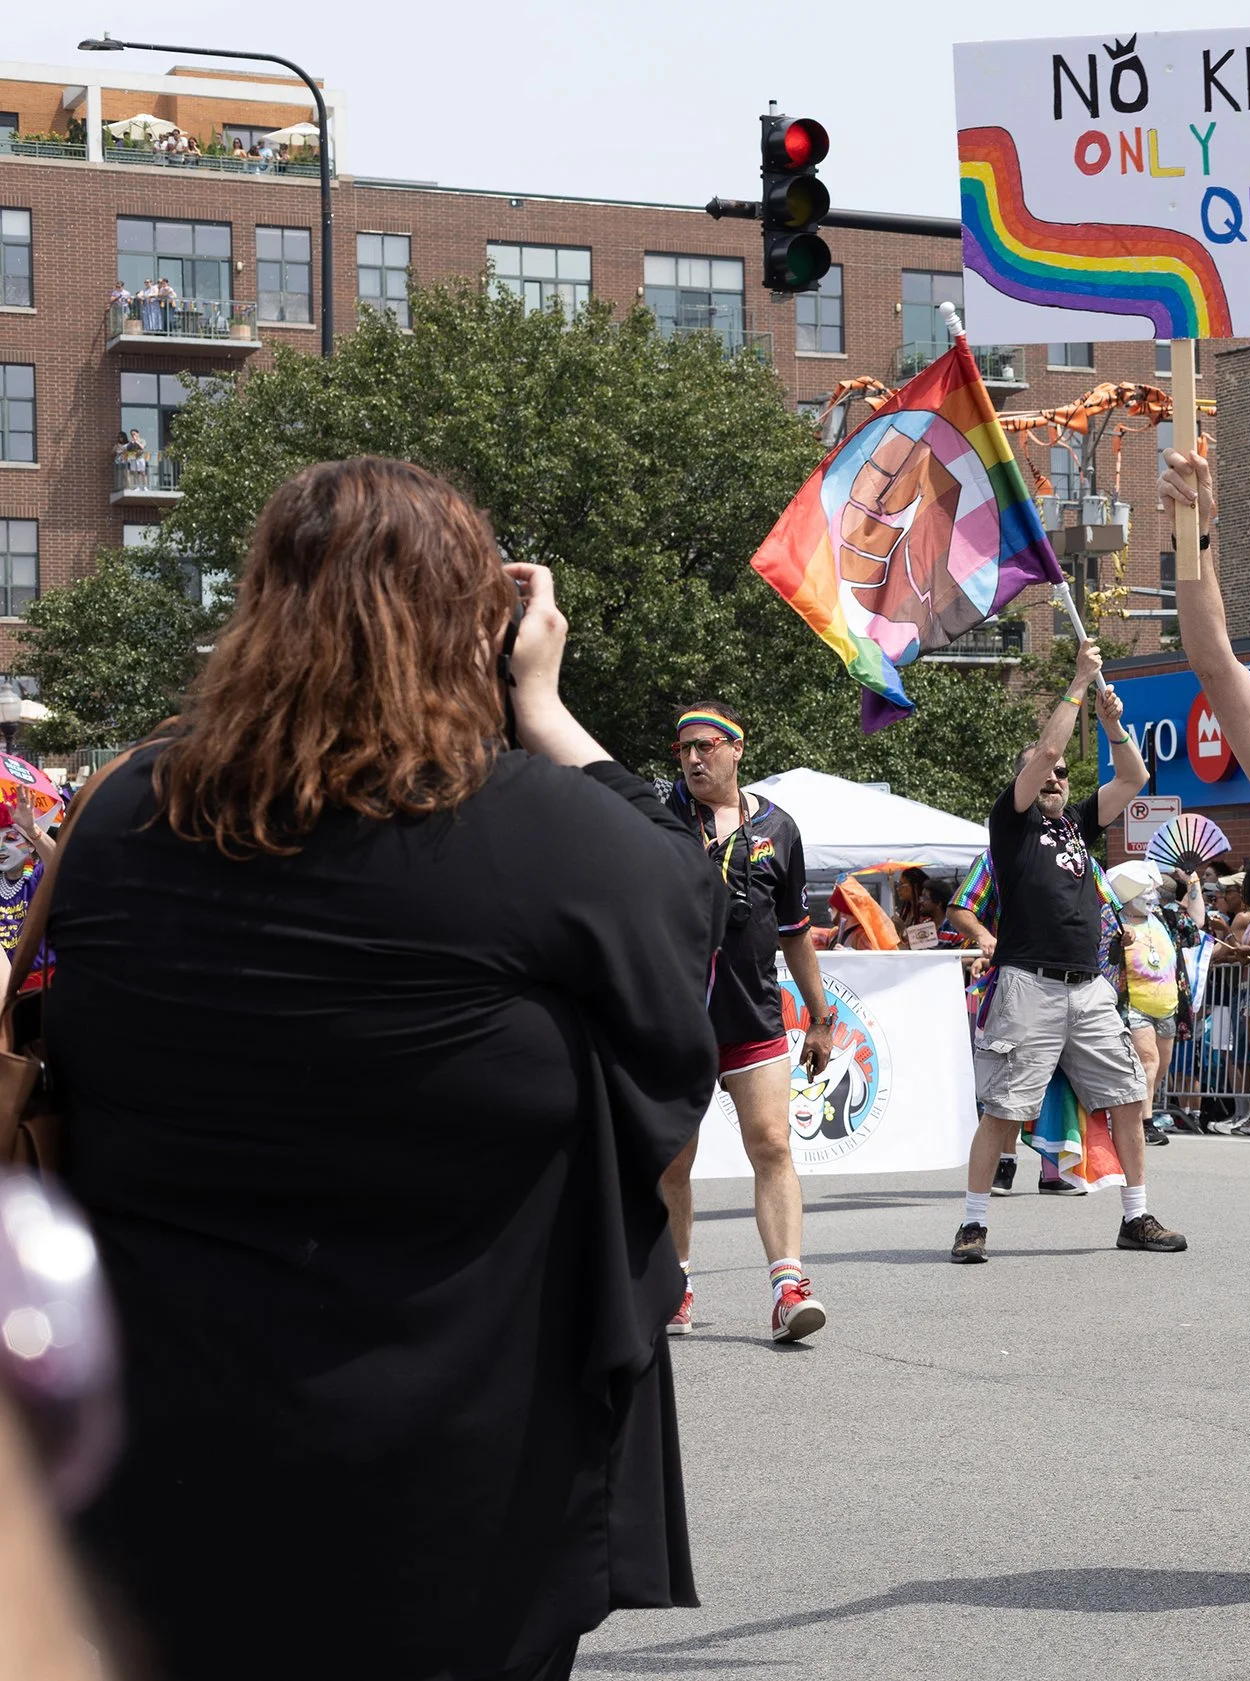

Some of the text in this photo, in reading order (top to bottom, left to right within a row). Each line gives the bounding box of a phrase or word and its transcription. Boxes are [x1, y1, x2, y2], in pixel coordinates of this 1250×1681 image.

[1052, 52, 1149, 120] NO
[1073, 121, 1217, 178] ONLY
[1106, 718, 1178, 767] MO
[822, 978, 868, 1021] SISTERS
